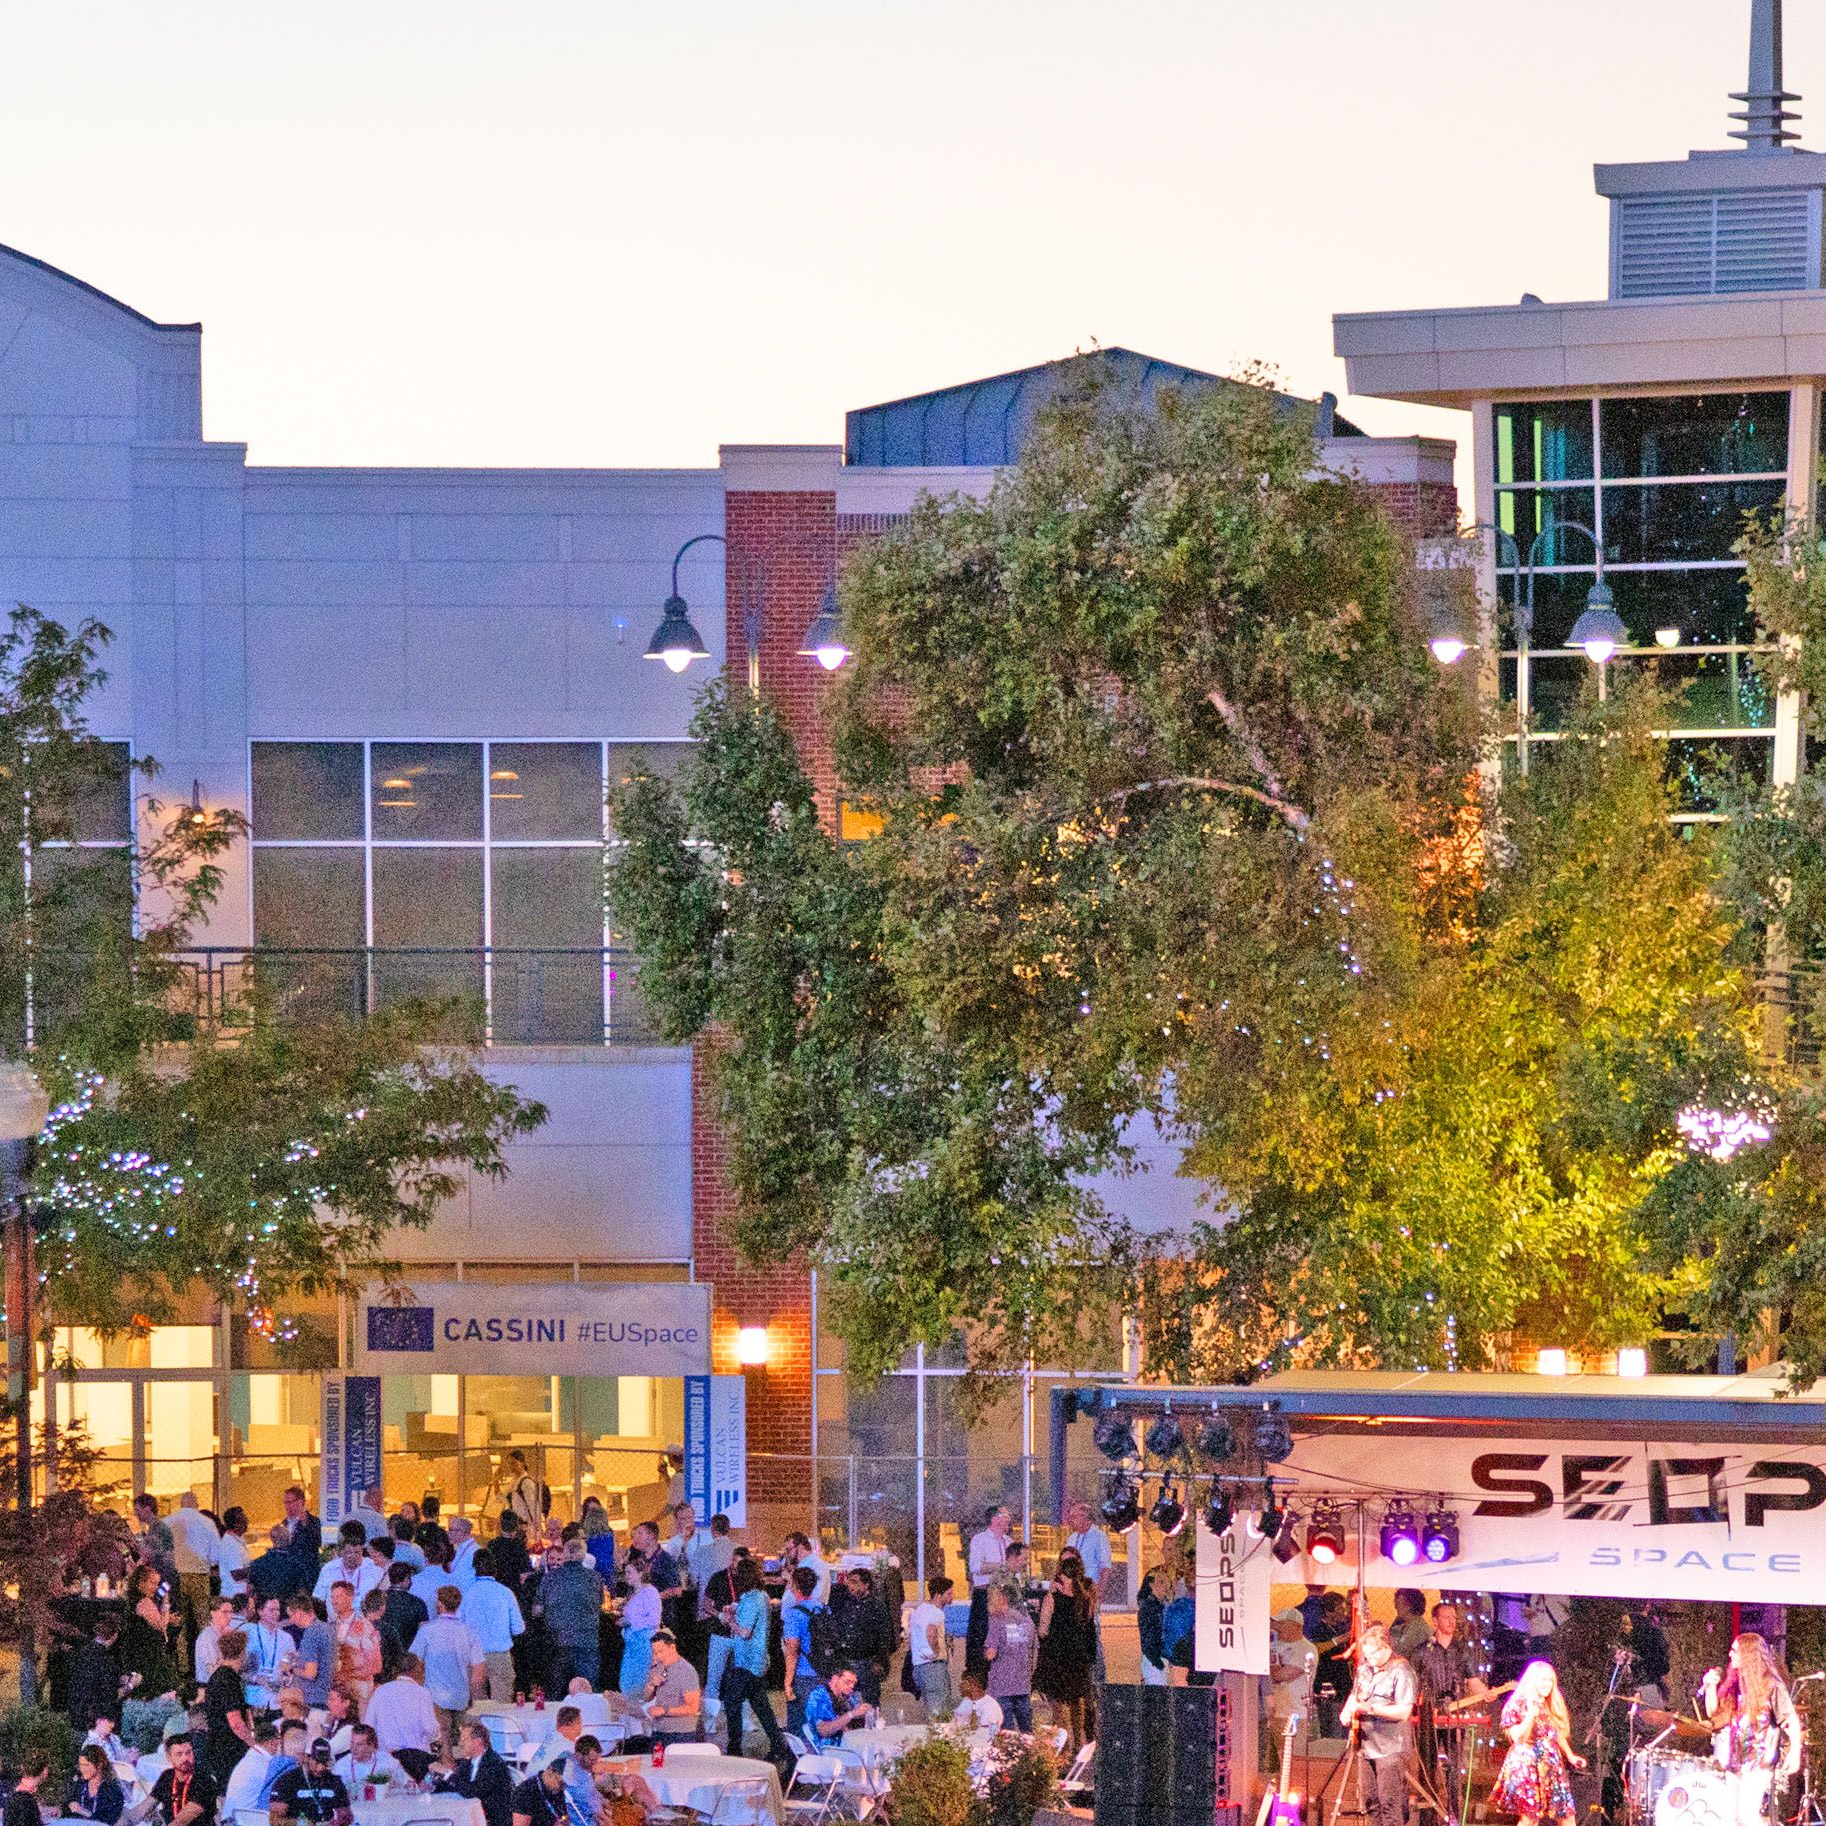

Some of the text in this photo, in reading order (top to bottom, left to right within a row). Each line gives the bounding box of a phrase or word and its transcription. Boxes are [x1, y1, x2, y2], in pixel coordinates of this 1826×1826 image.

[443, 1317, 699, 1347] CASSINI #EUSpace
[690, 1380, 705, 1395] BY
[327, 1381, 340, 1522] FOOD TRUCKS SPONSORED BY
[364, 1418, 376, 1486] WIRELESS
[690, 1397, 705, 1454] SPONSORED
[729, 1418, 740, 1484] WIRELESS
[351, 1428, 362, 1486] VULCAN
[690, 1456, 705, 1494] TRUCKS
[716, 1427, 727, 1485] VULCAN
[1588, 1547, 1802, 1574] SPACE
[1219, 1532, 1235, 1649] SEOPS
